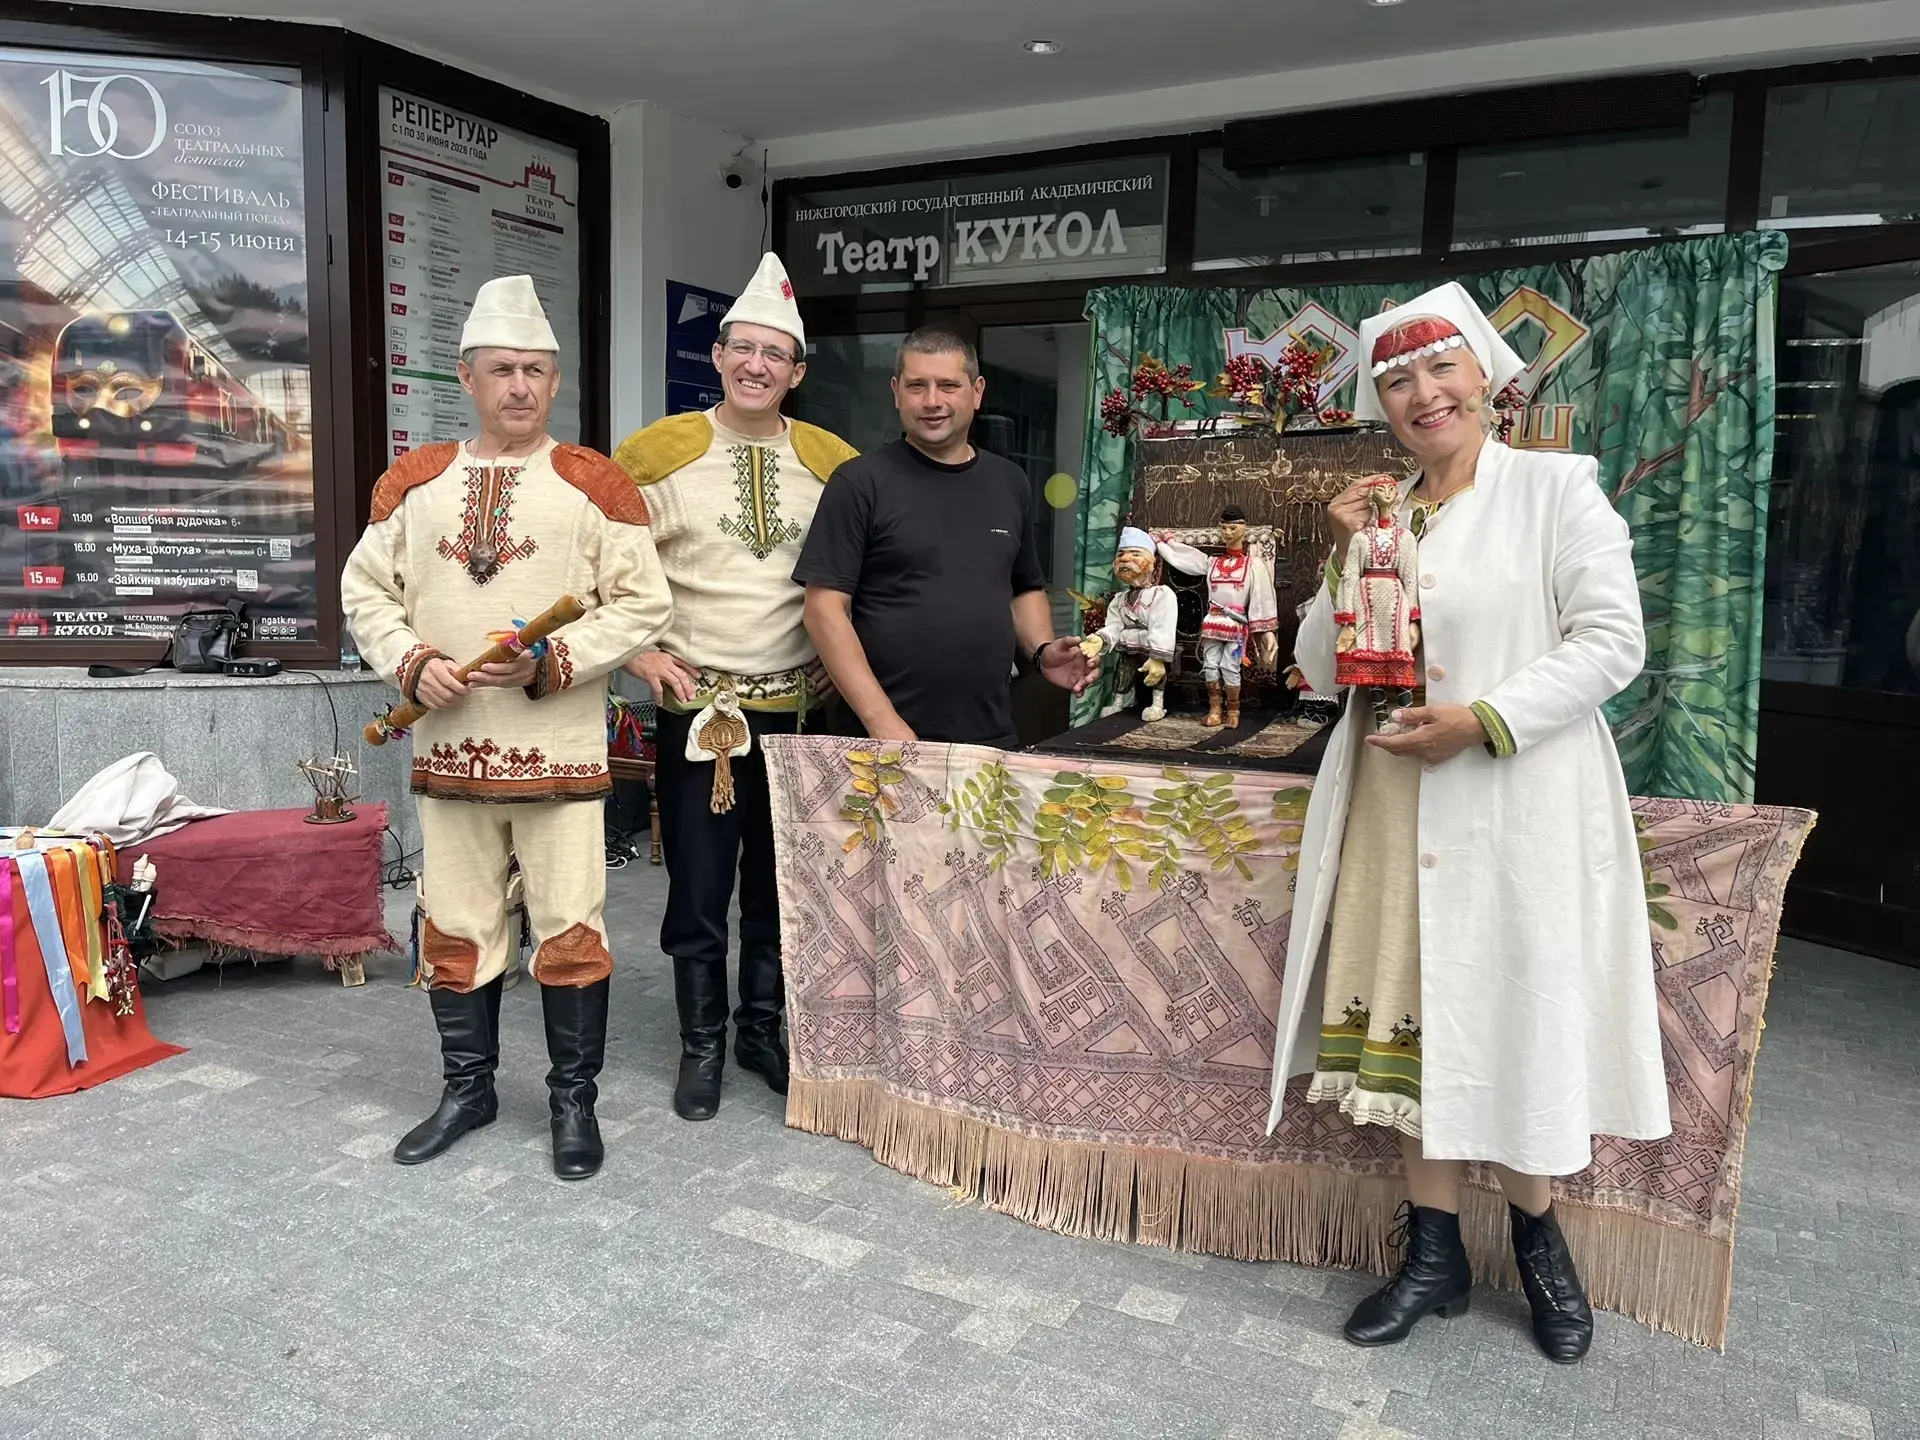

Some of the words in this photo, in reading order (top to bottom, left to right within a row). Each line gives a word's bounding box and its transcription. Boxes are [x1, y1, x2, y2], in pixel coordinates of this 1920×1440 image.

[39, 69, 167, 160] 150
[391, 95, 498, 149] РЕПЕРТУАР
[174, 122, 220, 136] СОЮЗ
[174, 138, 285, 158] ТЕАТРАЛЬНЫХ
[392, 123, 397, 132] С
[399, 125, 403, 134] 1
[404, 127, 415, 138] ПО
[416, 130, 425, 141] 30
[426, 133, 449, 148] ИЮНЯ
[450, 142, 468, 155] 2026
[469, 147, 488, 161] ГОДА
[174, 148, 248, 168] деятелей
[151, 181, 290, 209] ФЕСТИВАЛЬ
[525, 193, 554, 208] ТЕАТР
[795, 200, 897, 222] НИЖЕГОРОДСКИЙ
[901, 187, 1024, 213] ГОСУДАРСТВЕННЫЙ
[1030, 174, 1154, 201] АКАДЕМИЧЕСКИЙ
[525, 205, 556, 221] КУКОЛ
[164, 228, 221, 253] 14-15
[816, 231, 940, 281] Театр
[954, 207, 1127, 264] КУКОЛ
[24, 512, 39, 525] 14
[41, 517, 54, 525] вс.
[72, 513, 93, 523] 11:00
[104, 513, 175, 525] «Волшебная
[176, 516, 228, 528] дудочка»
[231, 517, 242, 527] 6+
[73, 542, 96, 552] 16.00
[105, 542, 202, 556] «Муха-цокотуха»
[256, 547, 267, 556] 0+
[29, 571, 44, 584] 15
[45, 576, 59, 584] пн.
[76, 572, 99, 582] 16.00
[107, 573, 161, 585] «Зайкина
[163, 575, 216, 588] избушка»
[220, 576, 231, 587] 0+
[52, 611, 108, 622] ТЕАТР
[261, 616, 297, 626] ngatk.ru
[53, 624, 115, 636] КУКОЛ
